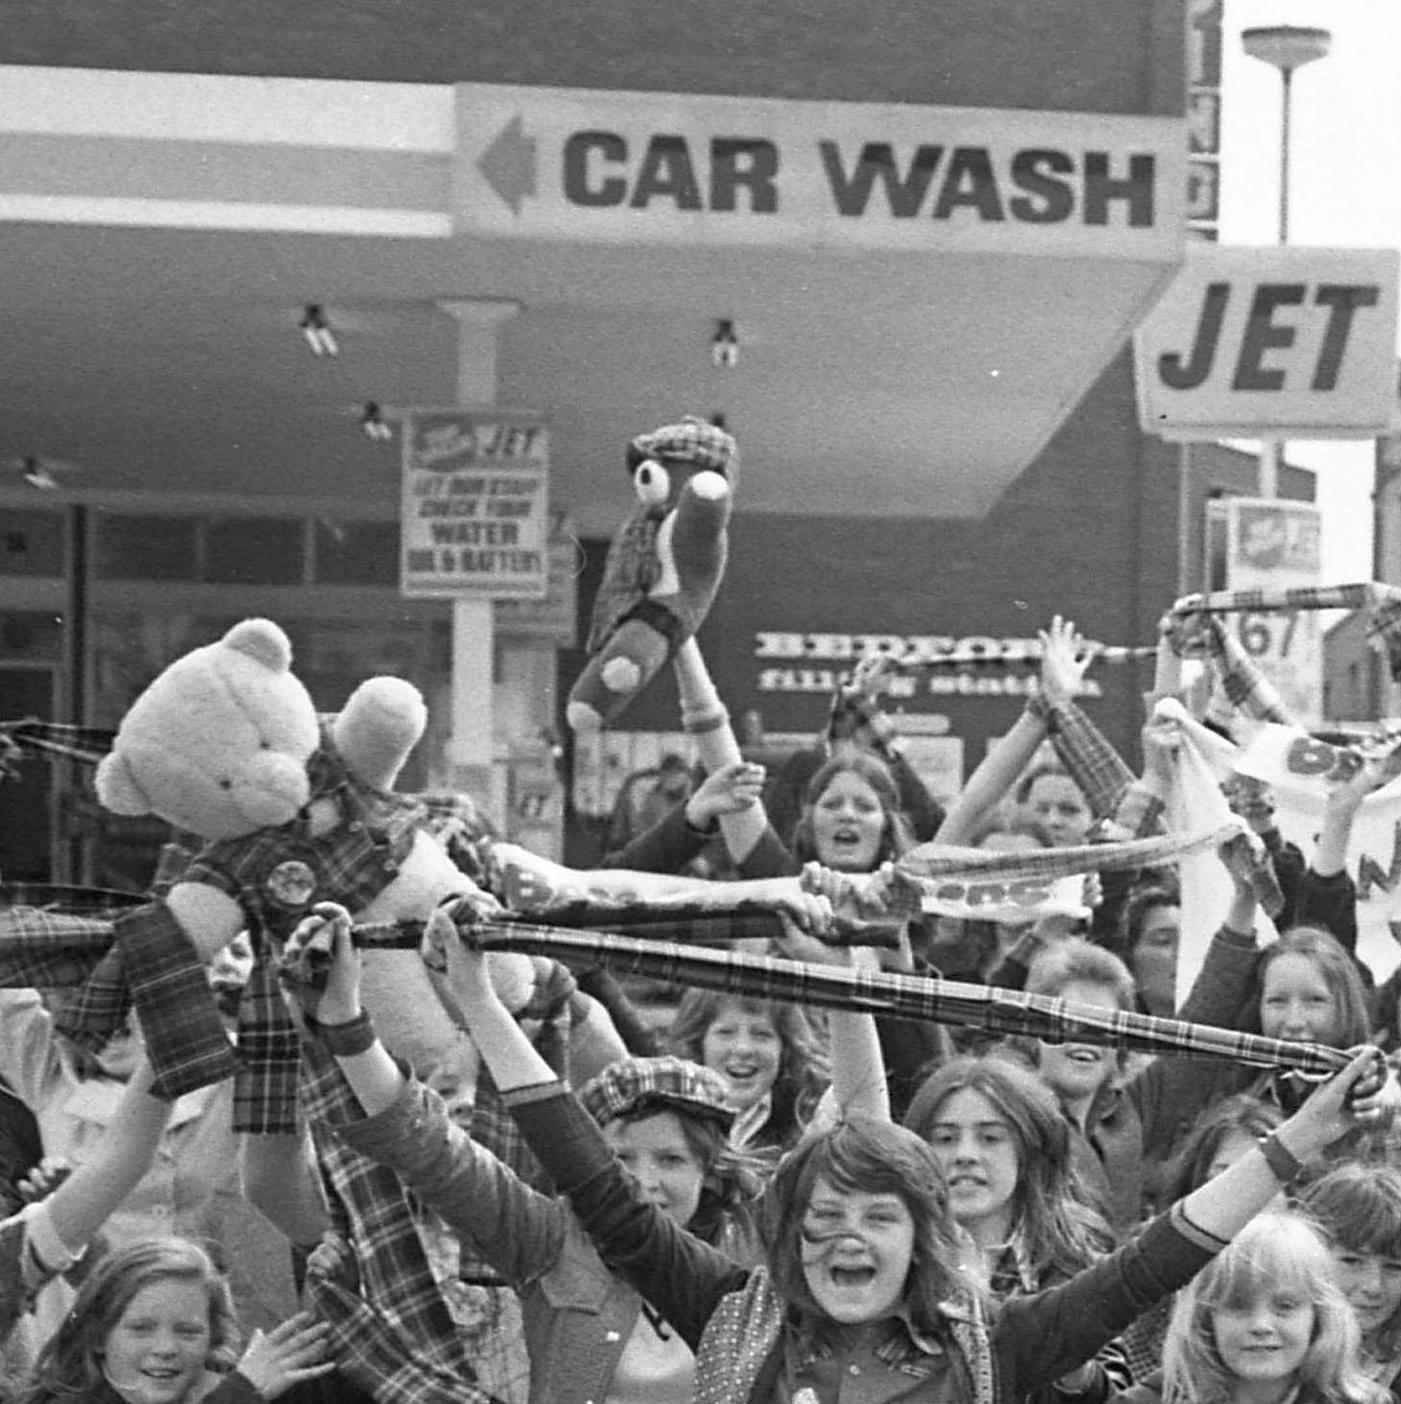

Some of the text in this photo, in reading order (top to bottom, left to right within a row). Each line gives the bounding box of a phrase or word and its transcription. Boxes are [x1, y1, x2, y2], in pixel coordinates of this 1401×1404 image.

[562, 131, 1156, 228] CAR WASH
[1158, 283, 1380, 393] JET
[431, 521, 520, 546] WATER
